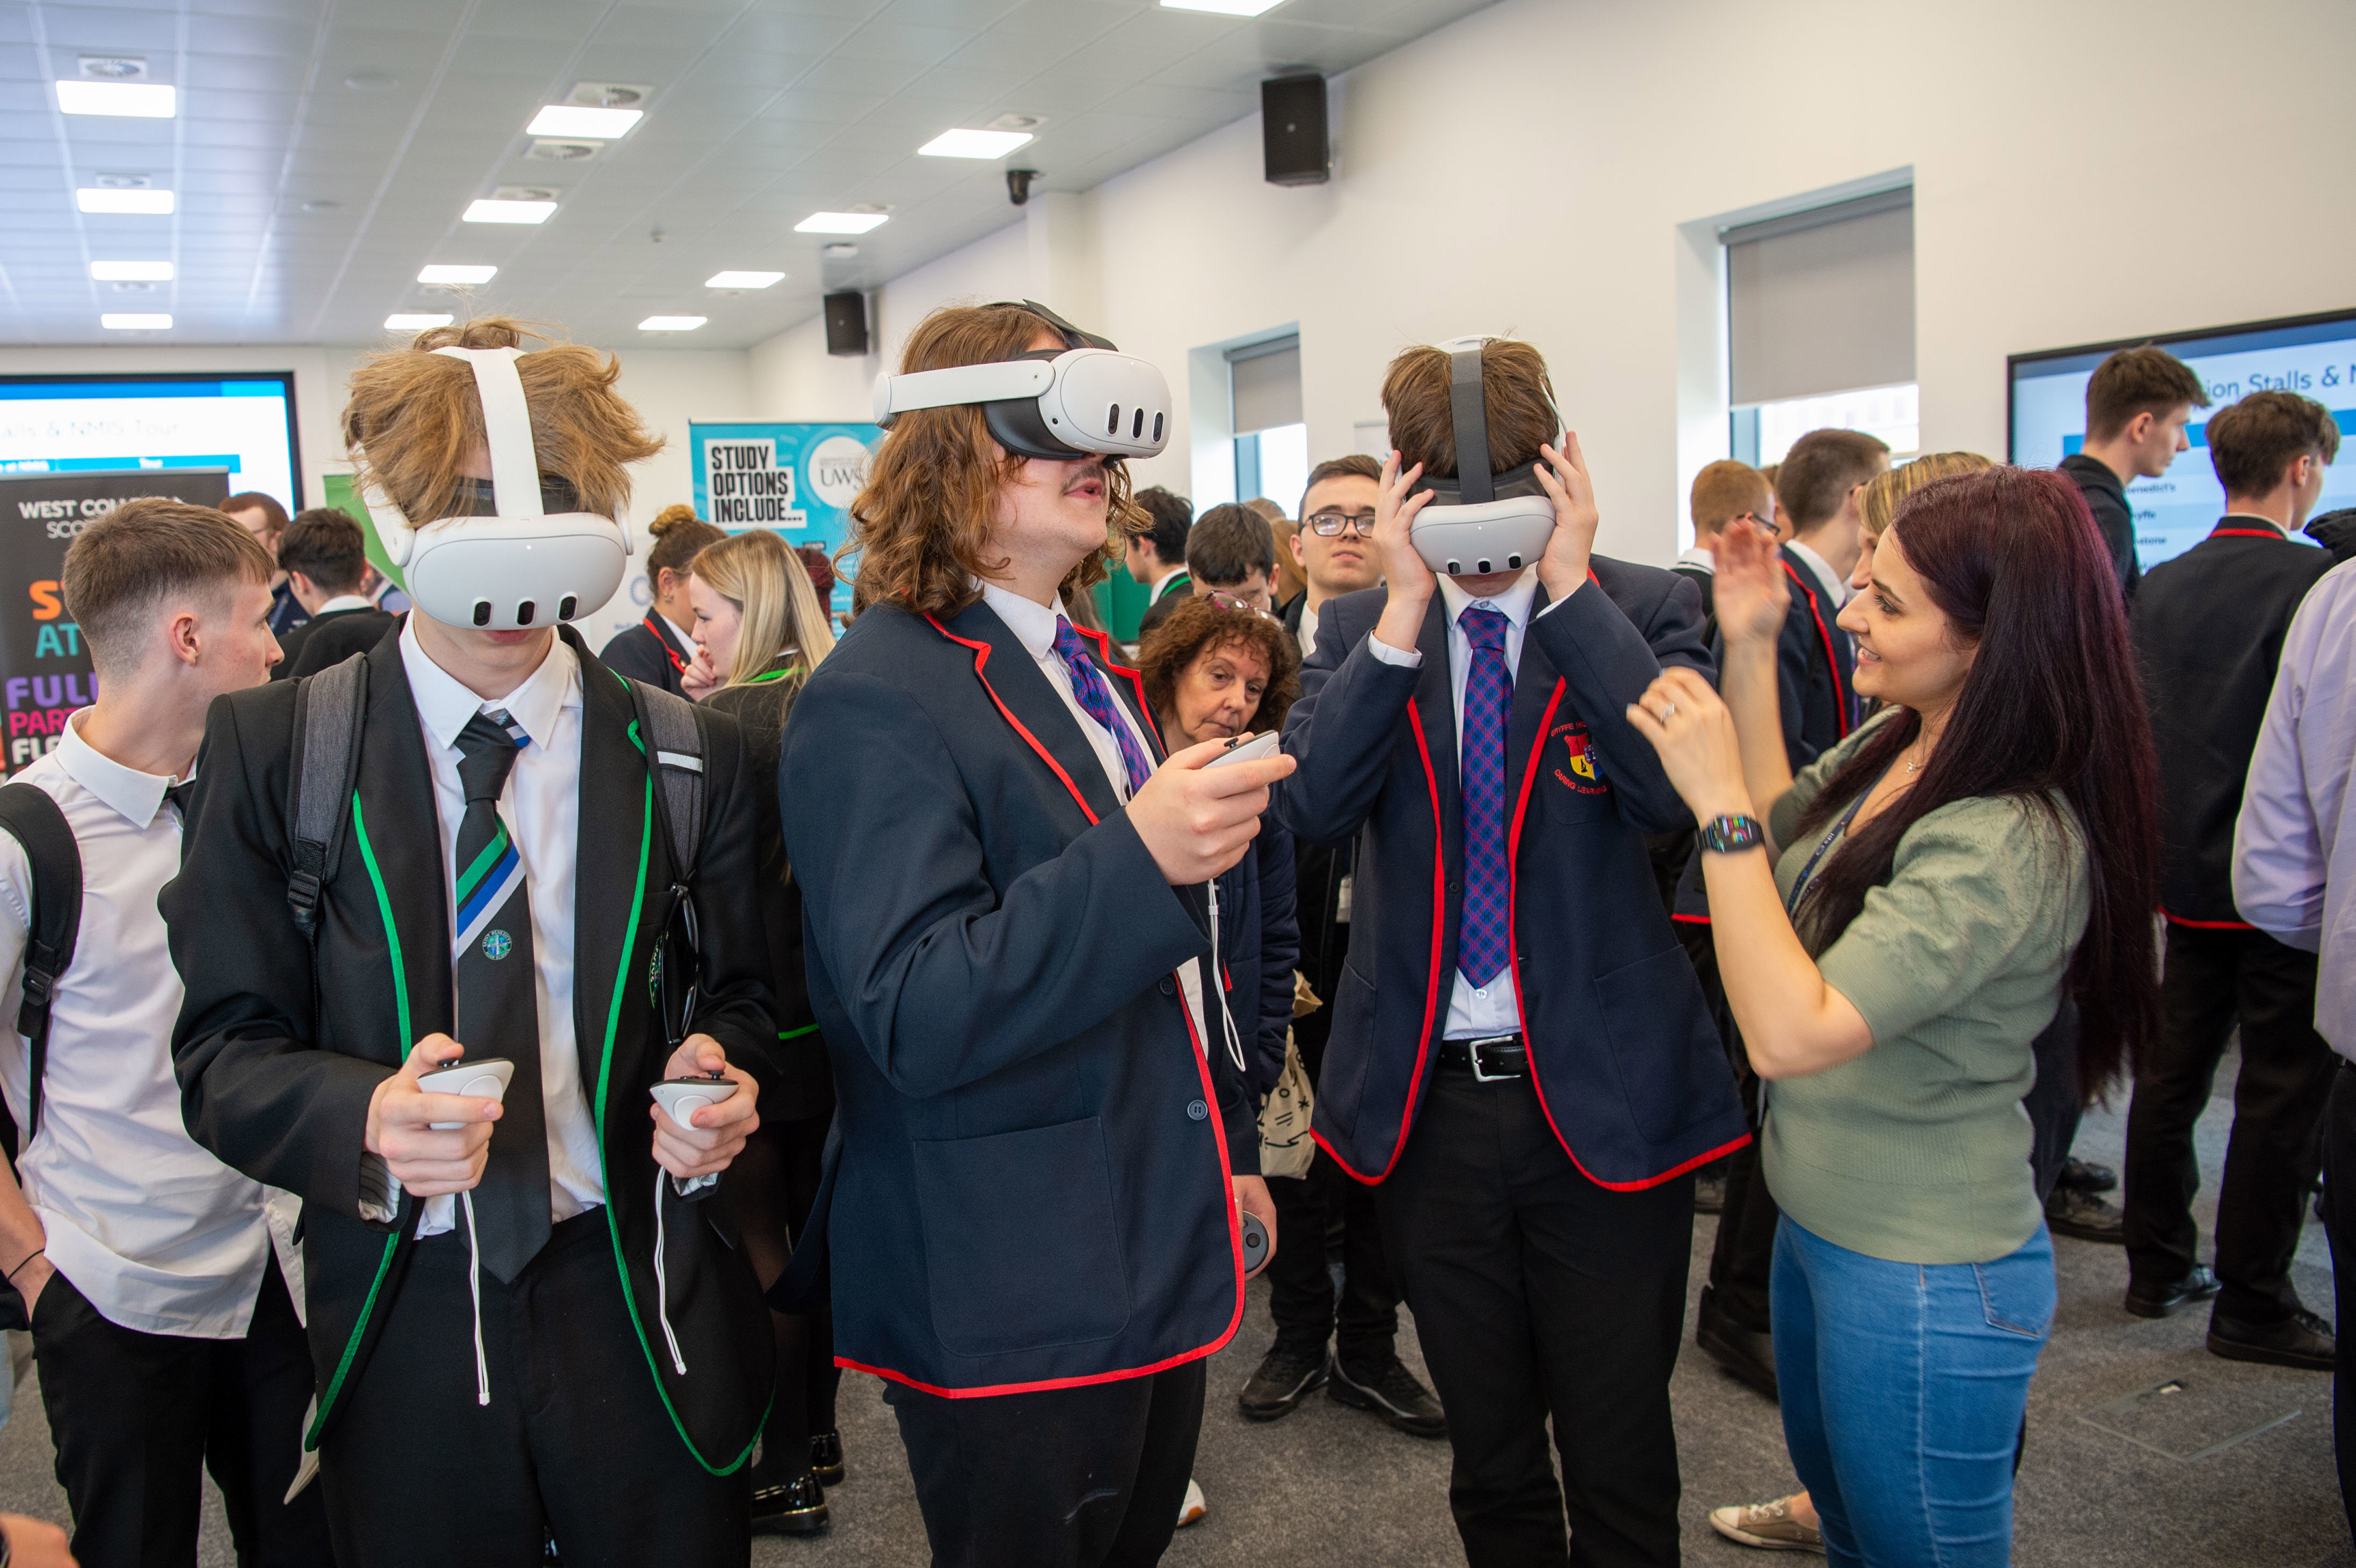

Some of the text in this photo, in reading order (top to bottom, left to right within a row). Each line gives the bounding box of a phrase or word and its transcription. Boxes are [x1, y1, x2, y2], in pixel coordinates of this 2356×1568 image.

[2207, 380, 2240, 398] ion
[2249, 369, 2312, 393] Stalls
[2322, 365, 2341, 387] &
[711, 446, 769, 470] STUDY
[714, 471, 788, 496] OPTIONS
[18, 499, 78, 519] WEST
[46, 520, 88, 539] SCO
[29, 580, 64, 621] S
[35, 622, 81, 659] AT
[1554, 769, 1608, 795] CARING LEARNING
